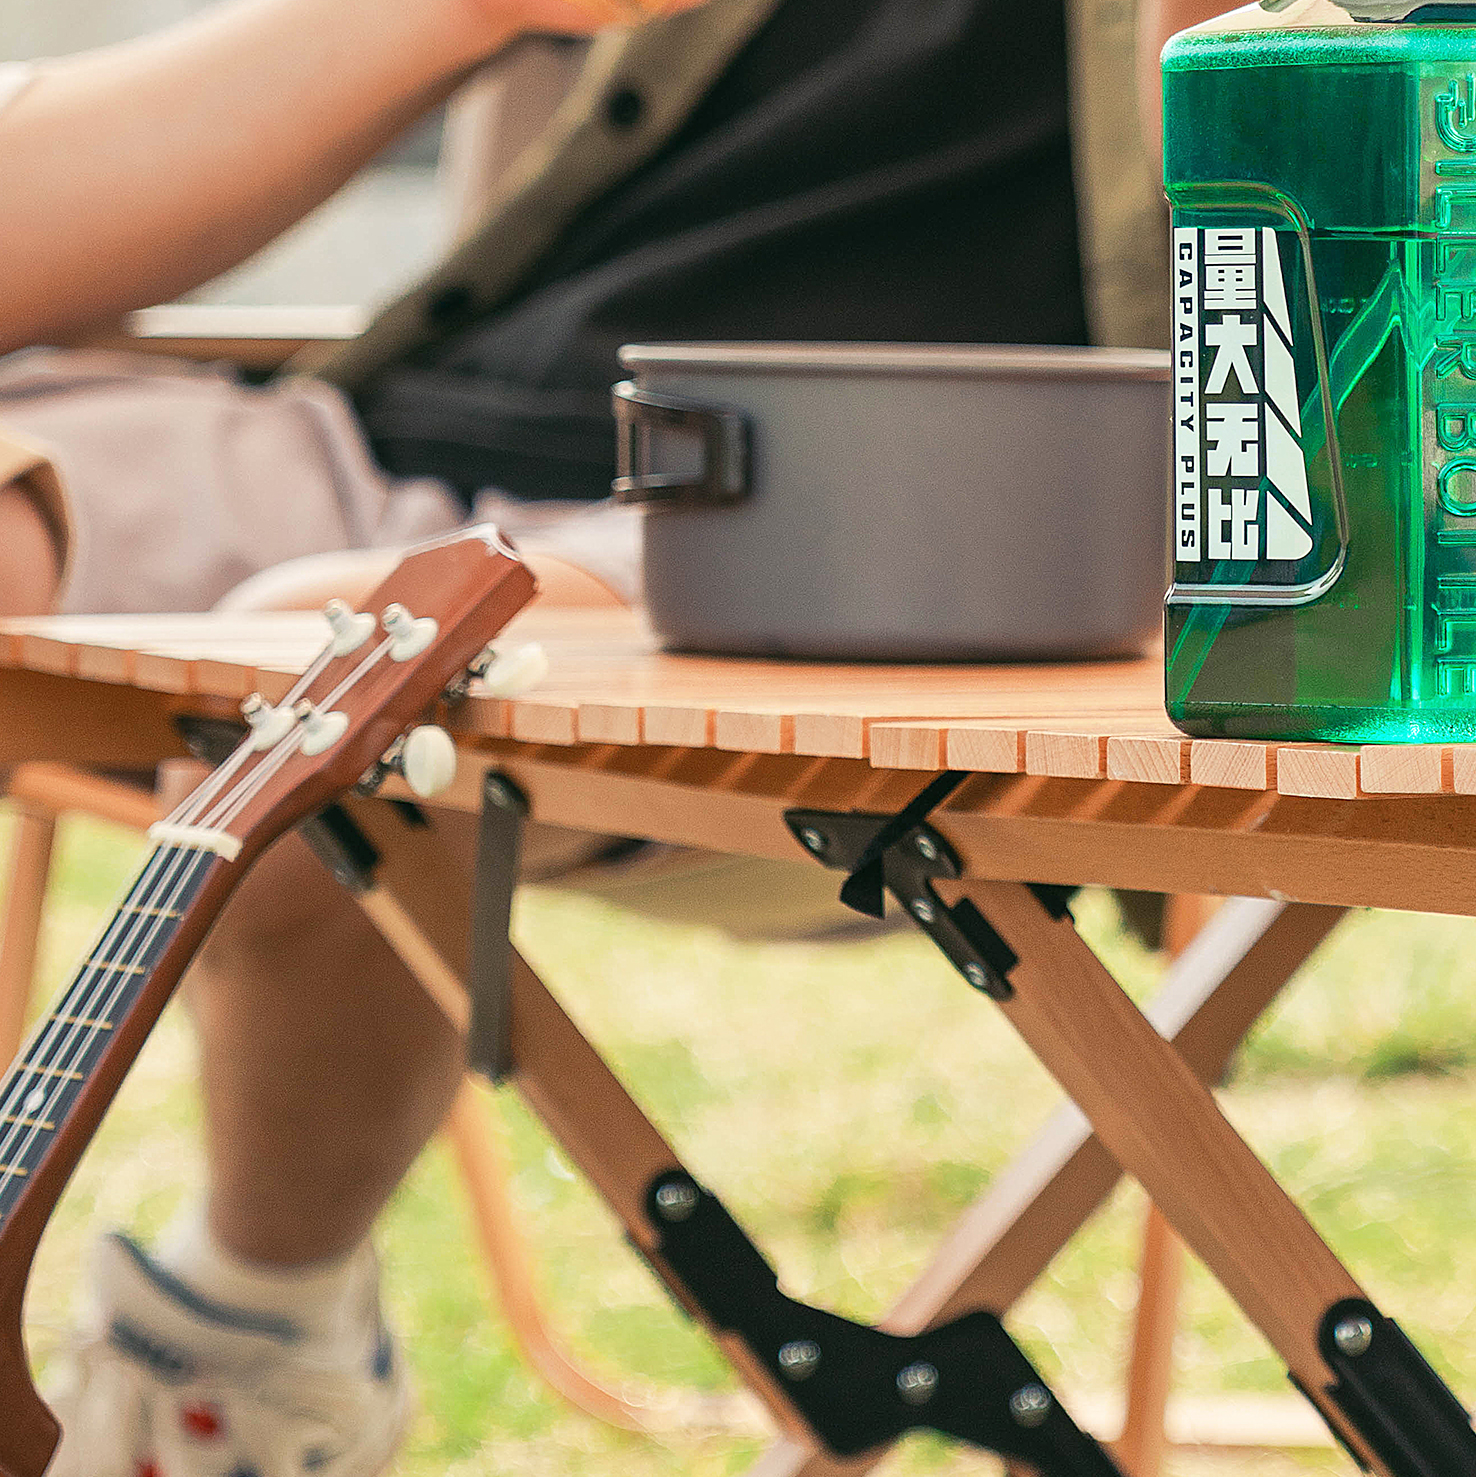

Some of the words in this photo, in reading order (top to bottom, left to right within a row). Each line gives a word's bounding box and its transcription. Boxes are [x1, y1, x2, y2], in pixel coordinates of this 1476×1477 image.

[1178, 241, 1196, 433] CAPACITY
[1203, 227, 1260, 561] 量大无比
[1180, 455, 1197, 549] PLUS
